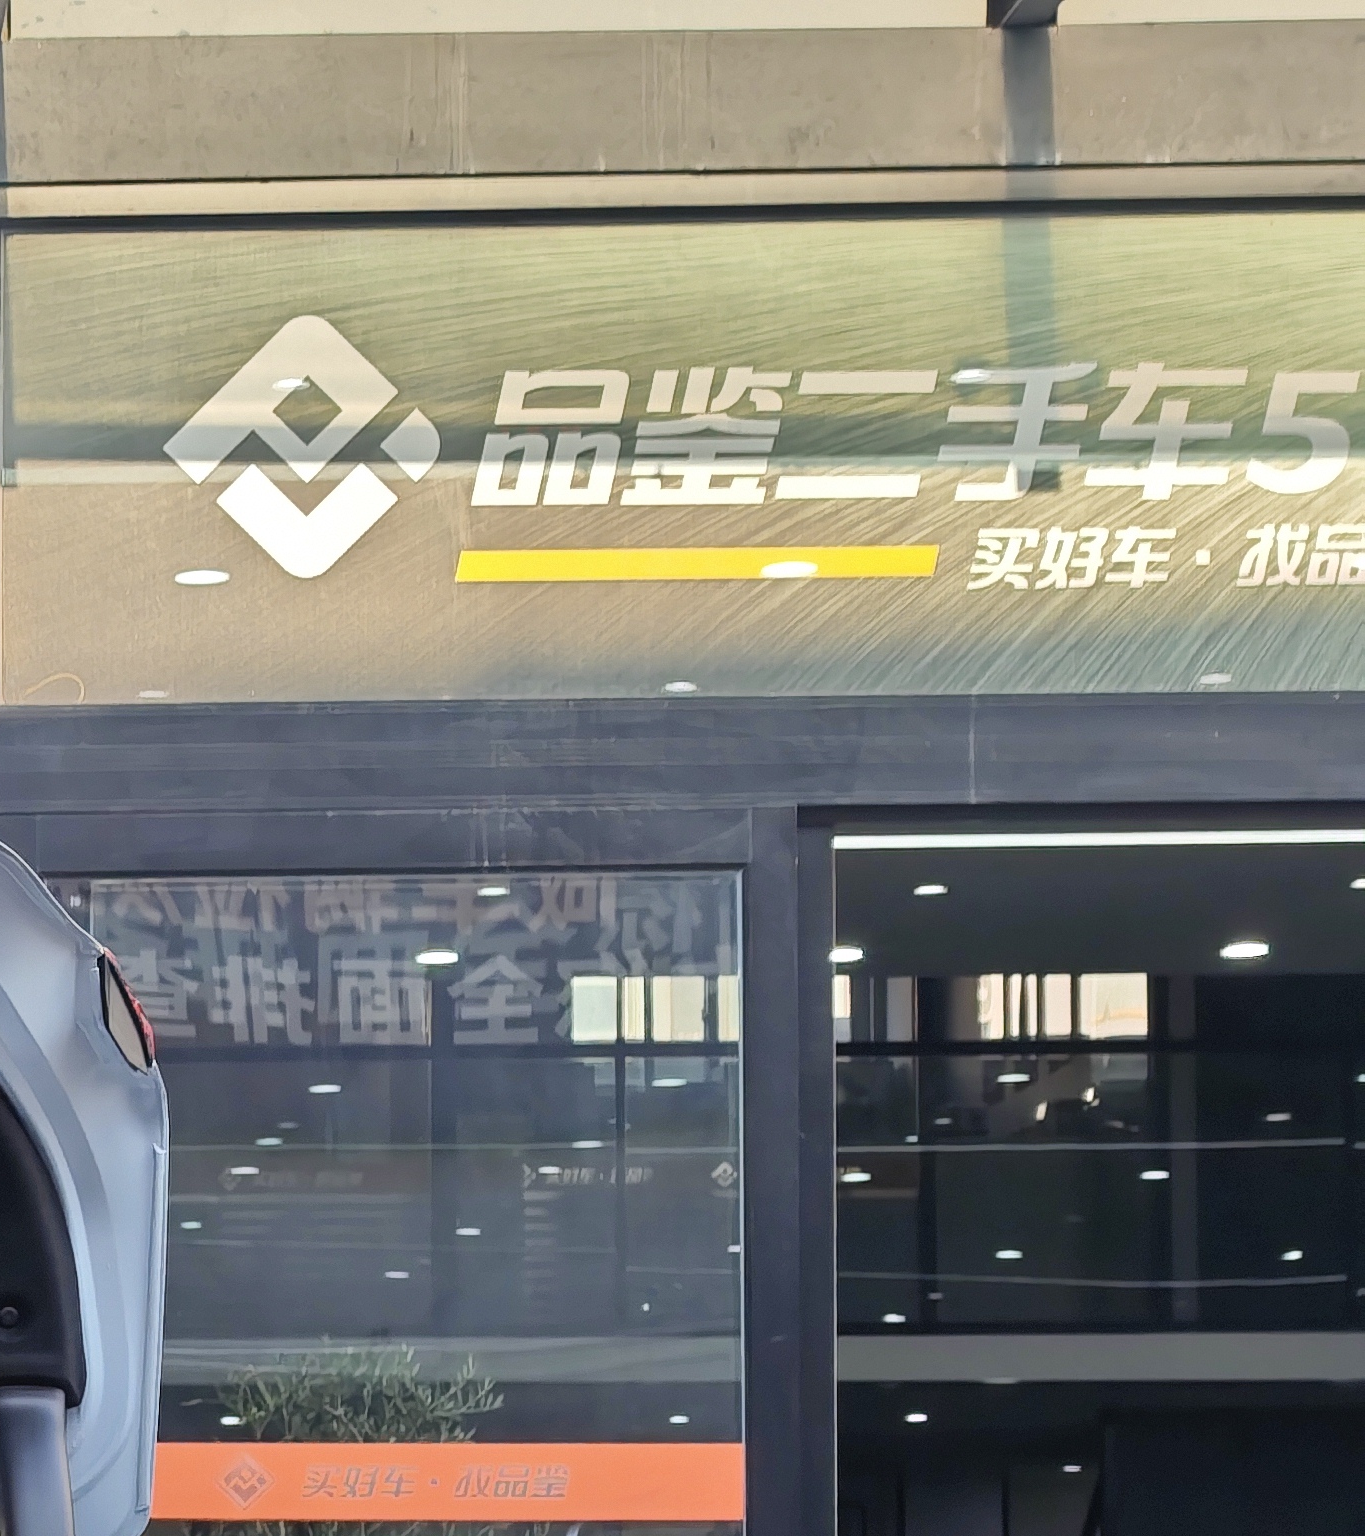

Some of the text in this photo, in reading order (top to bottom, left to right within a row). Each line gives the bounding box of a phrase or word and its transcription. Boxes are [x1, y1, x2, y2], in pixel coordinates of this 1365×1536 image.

[470, 362, 1361, 506] 品鉴二手车5
